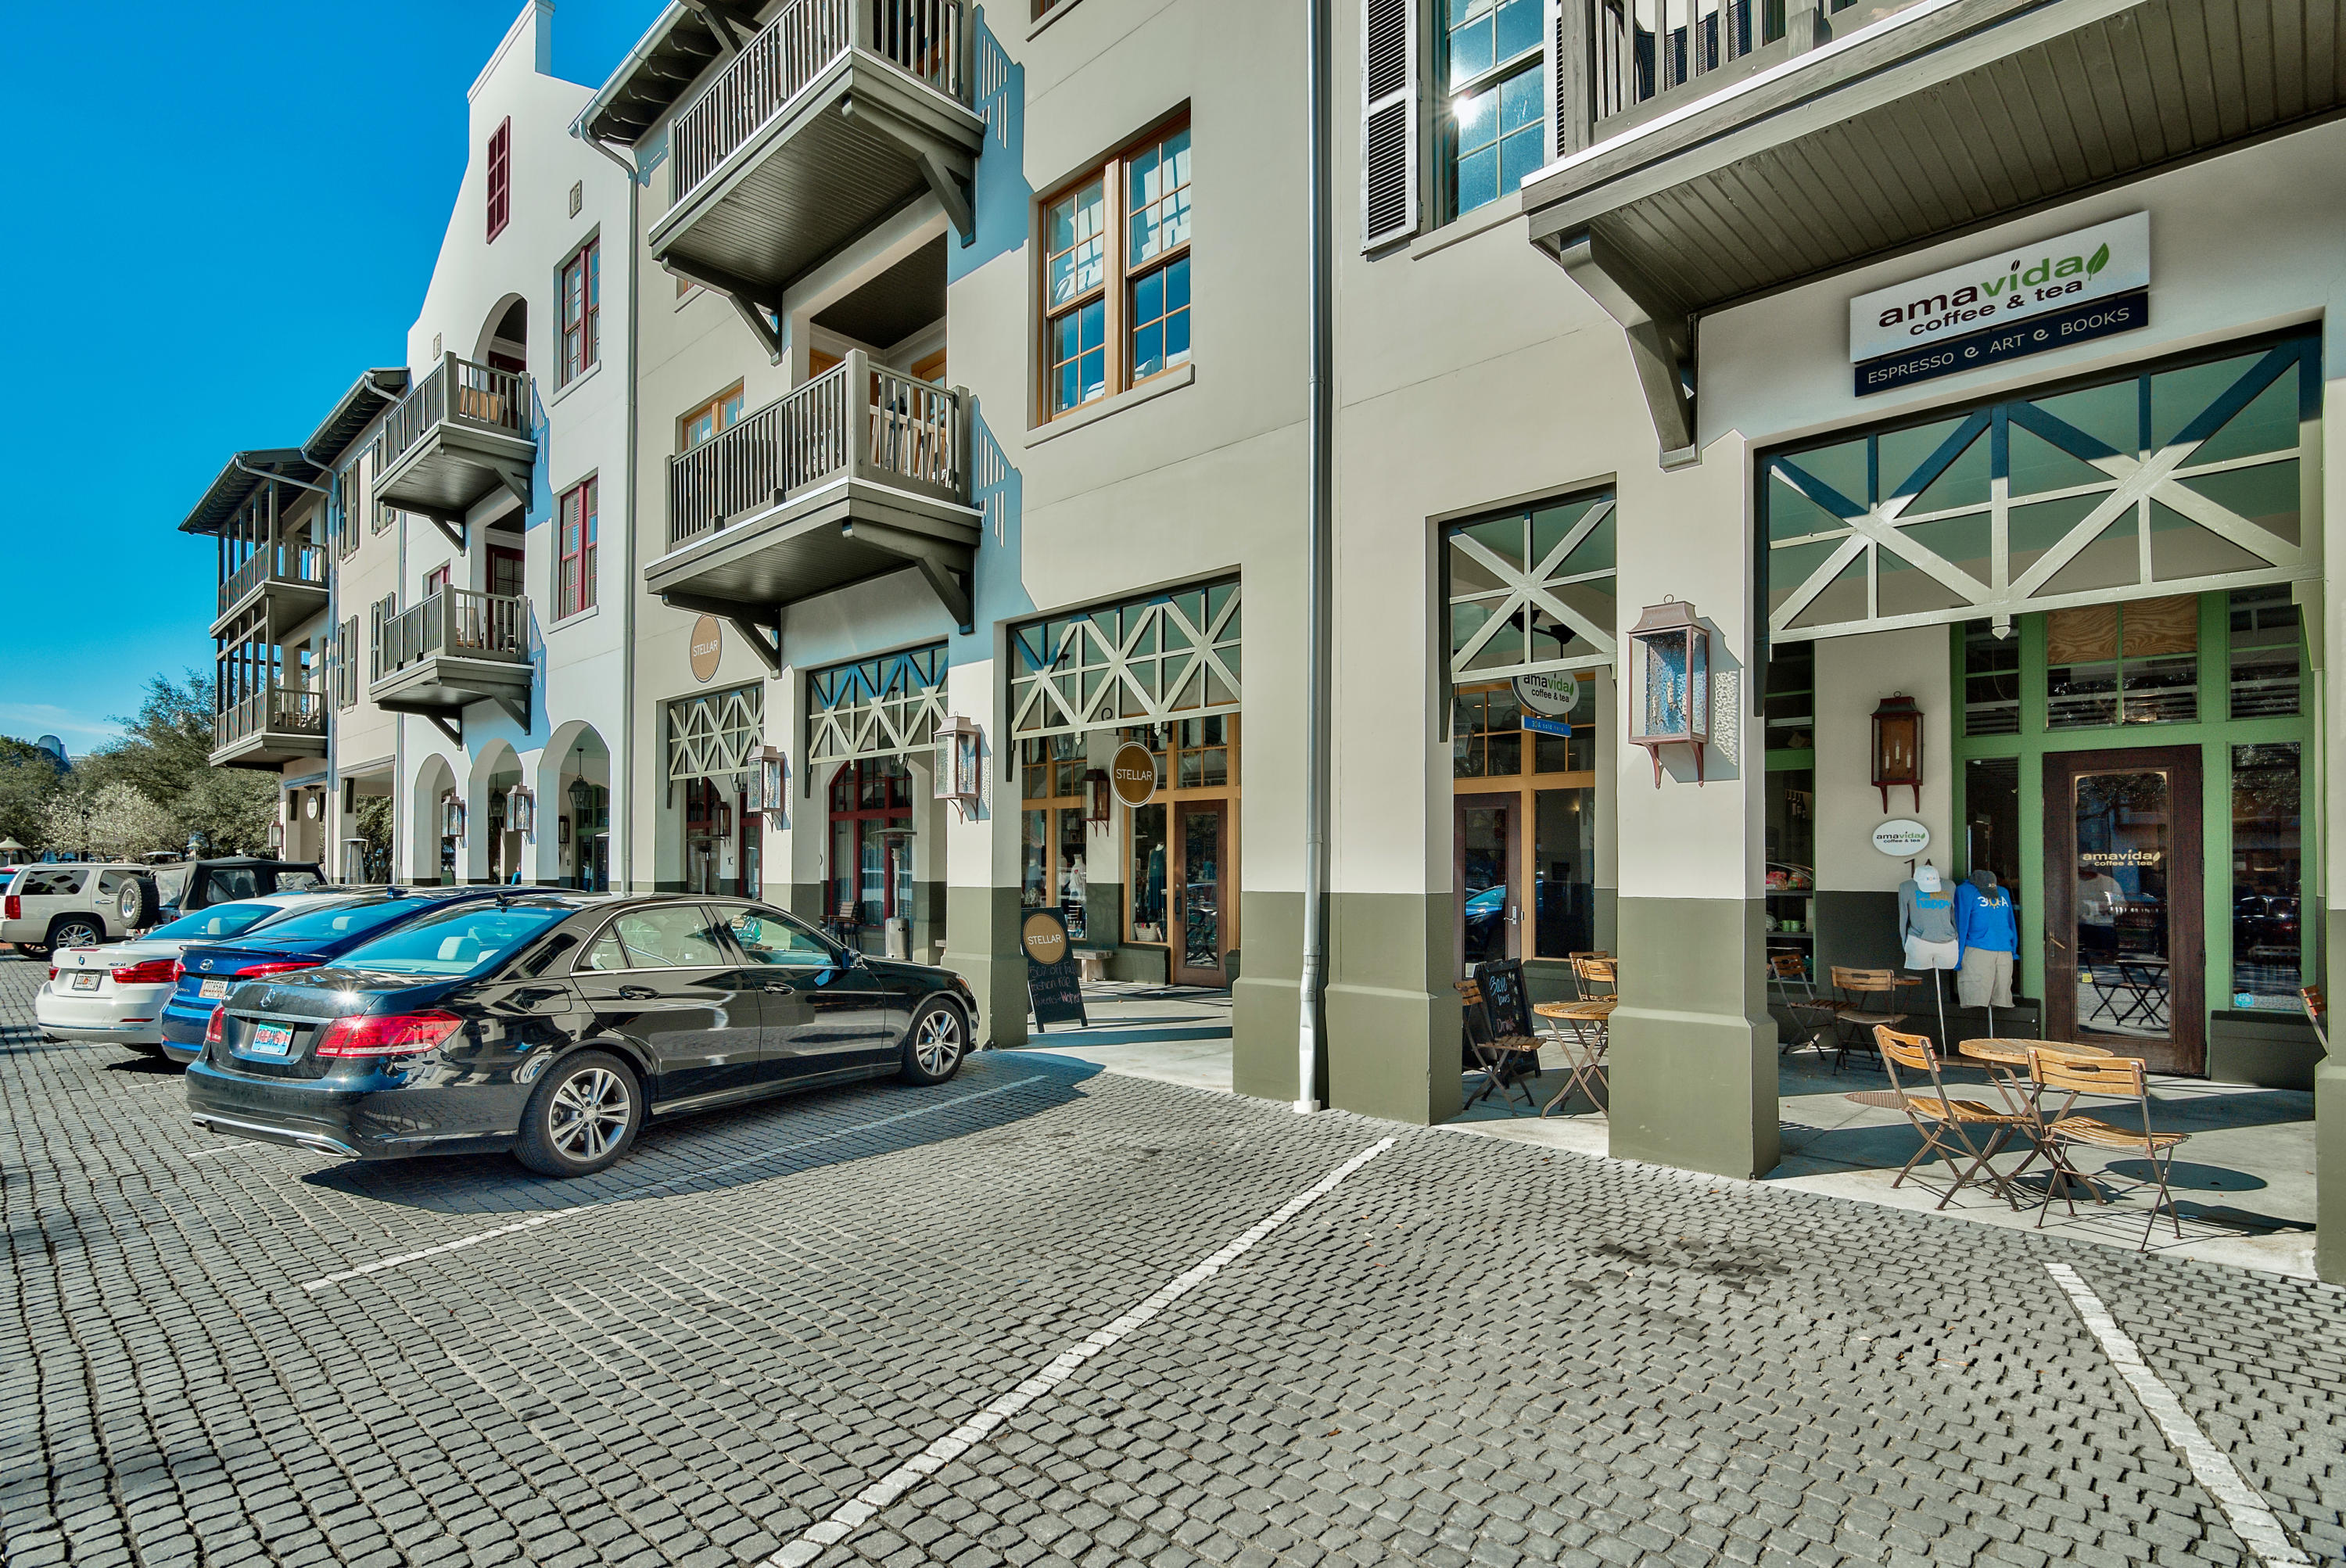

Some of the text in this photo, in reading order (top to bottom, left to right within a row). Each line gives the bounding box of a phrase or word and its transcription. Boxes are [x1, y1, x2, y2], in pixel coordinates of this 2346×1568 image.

[1878, 257, 2084, 328] amavida
[1910, 279, 2083, 335] coffee & tea
[1867, 352, 1954, 384] ESPRESSO
[1989, 334, 2025, 354] ART
[2061, 307, 2130, 335] BOOKS
[693, 640, 718, 657] STELLAR
[1523, 673, 1569, 693] amavida
[1531, 689, 1569, 702] coffee & tea
[1116, 769, 1153, 781] STELLAR
[1877, 831, 1921, 840] amavida
[2082, 849, 2153, 861] amavida
[1028, 934, 1062, 945] STELLAR
